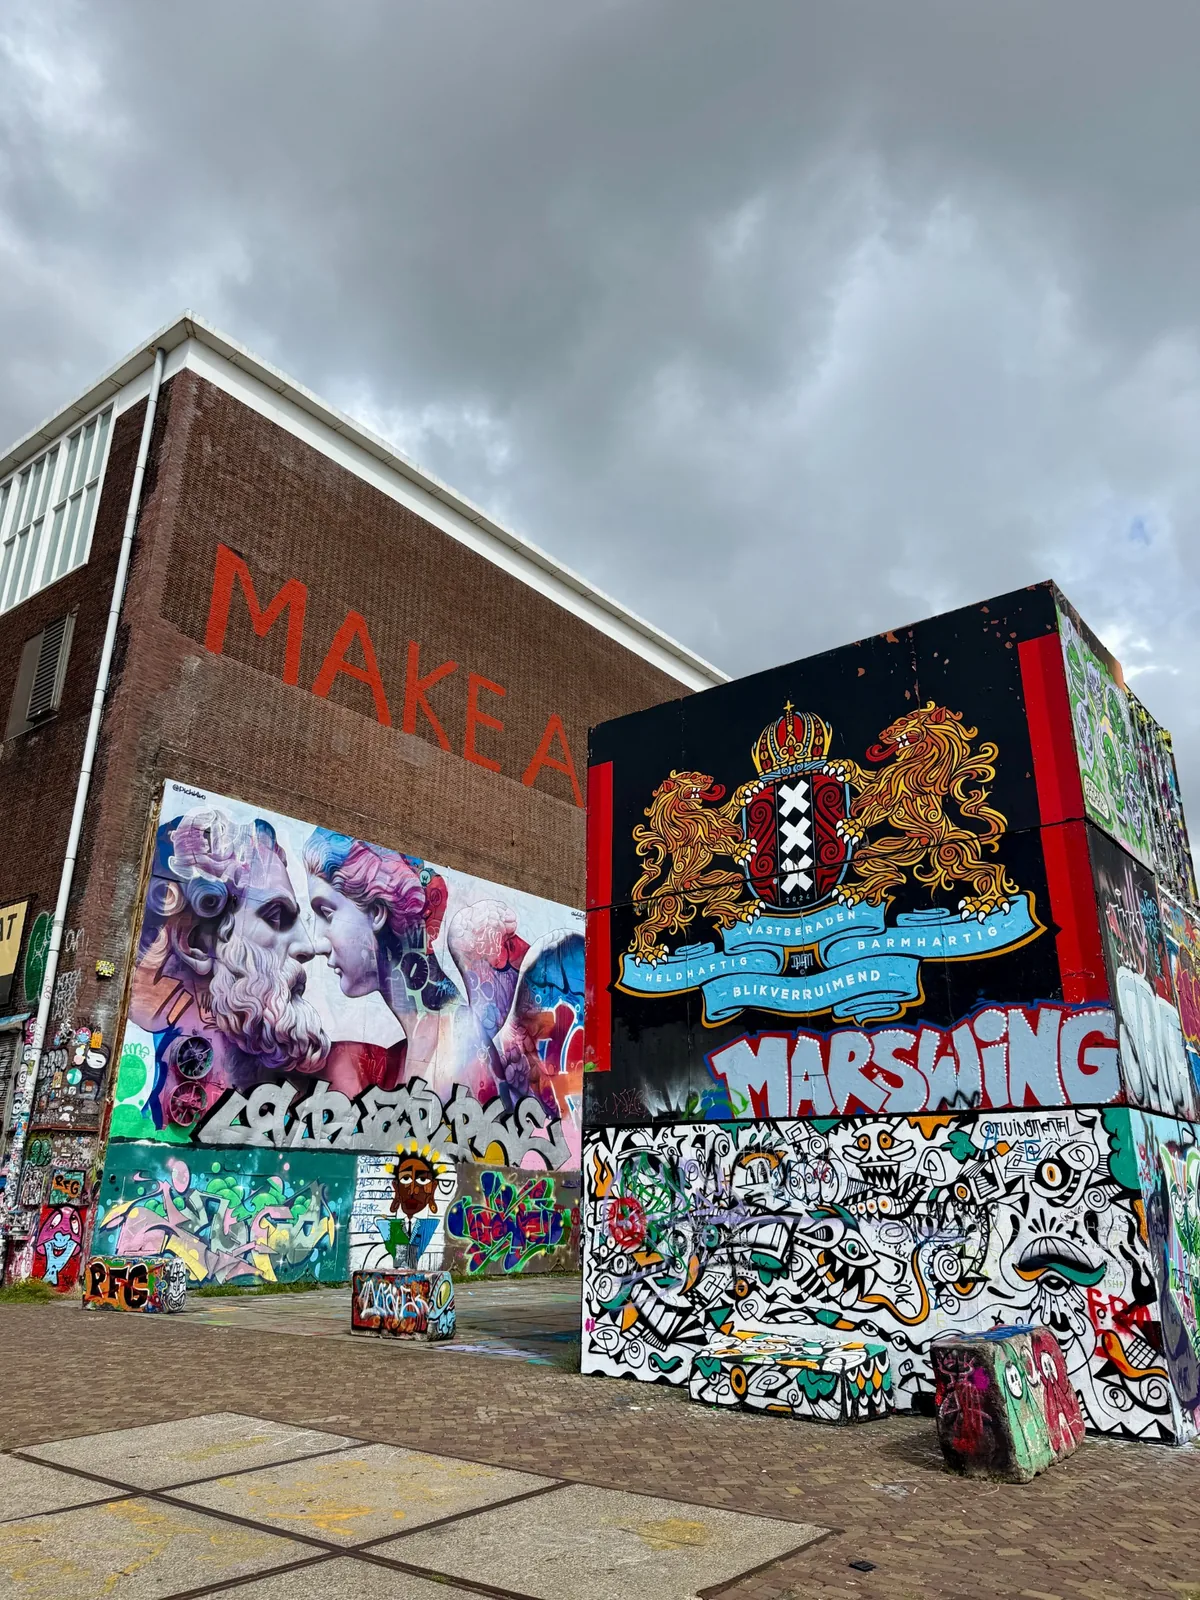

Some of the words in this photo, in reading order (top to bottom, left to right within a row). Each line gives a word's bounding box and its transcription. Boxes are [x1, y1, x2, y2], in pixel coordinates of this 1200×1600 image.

[204, 543, 506, 774] MAKE
[522, 713, 585, 809] A
[746, 911, 856, 937] VASTBERADEN
[857, 926, 998, 950] BARMHARTIG
[645, 956, 748, 982] HELDHAFTIG
[732, 969, 881, 1001] BLIKVERRUIMEND
